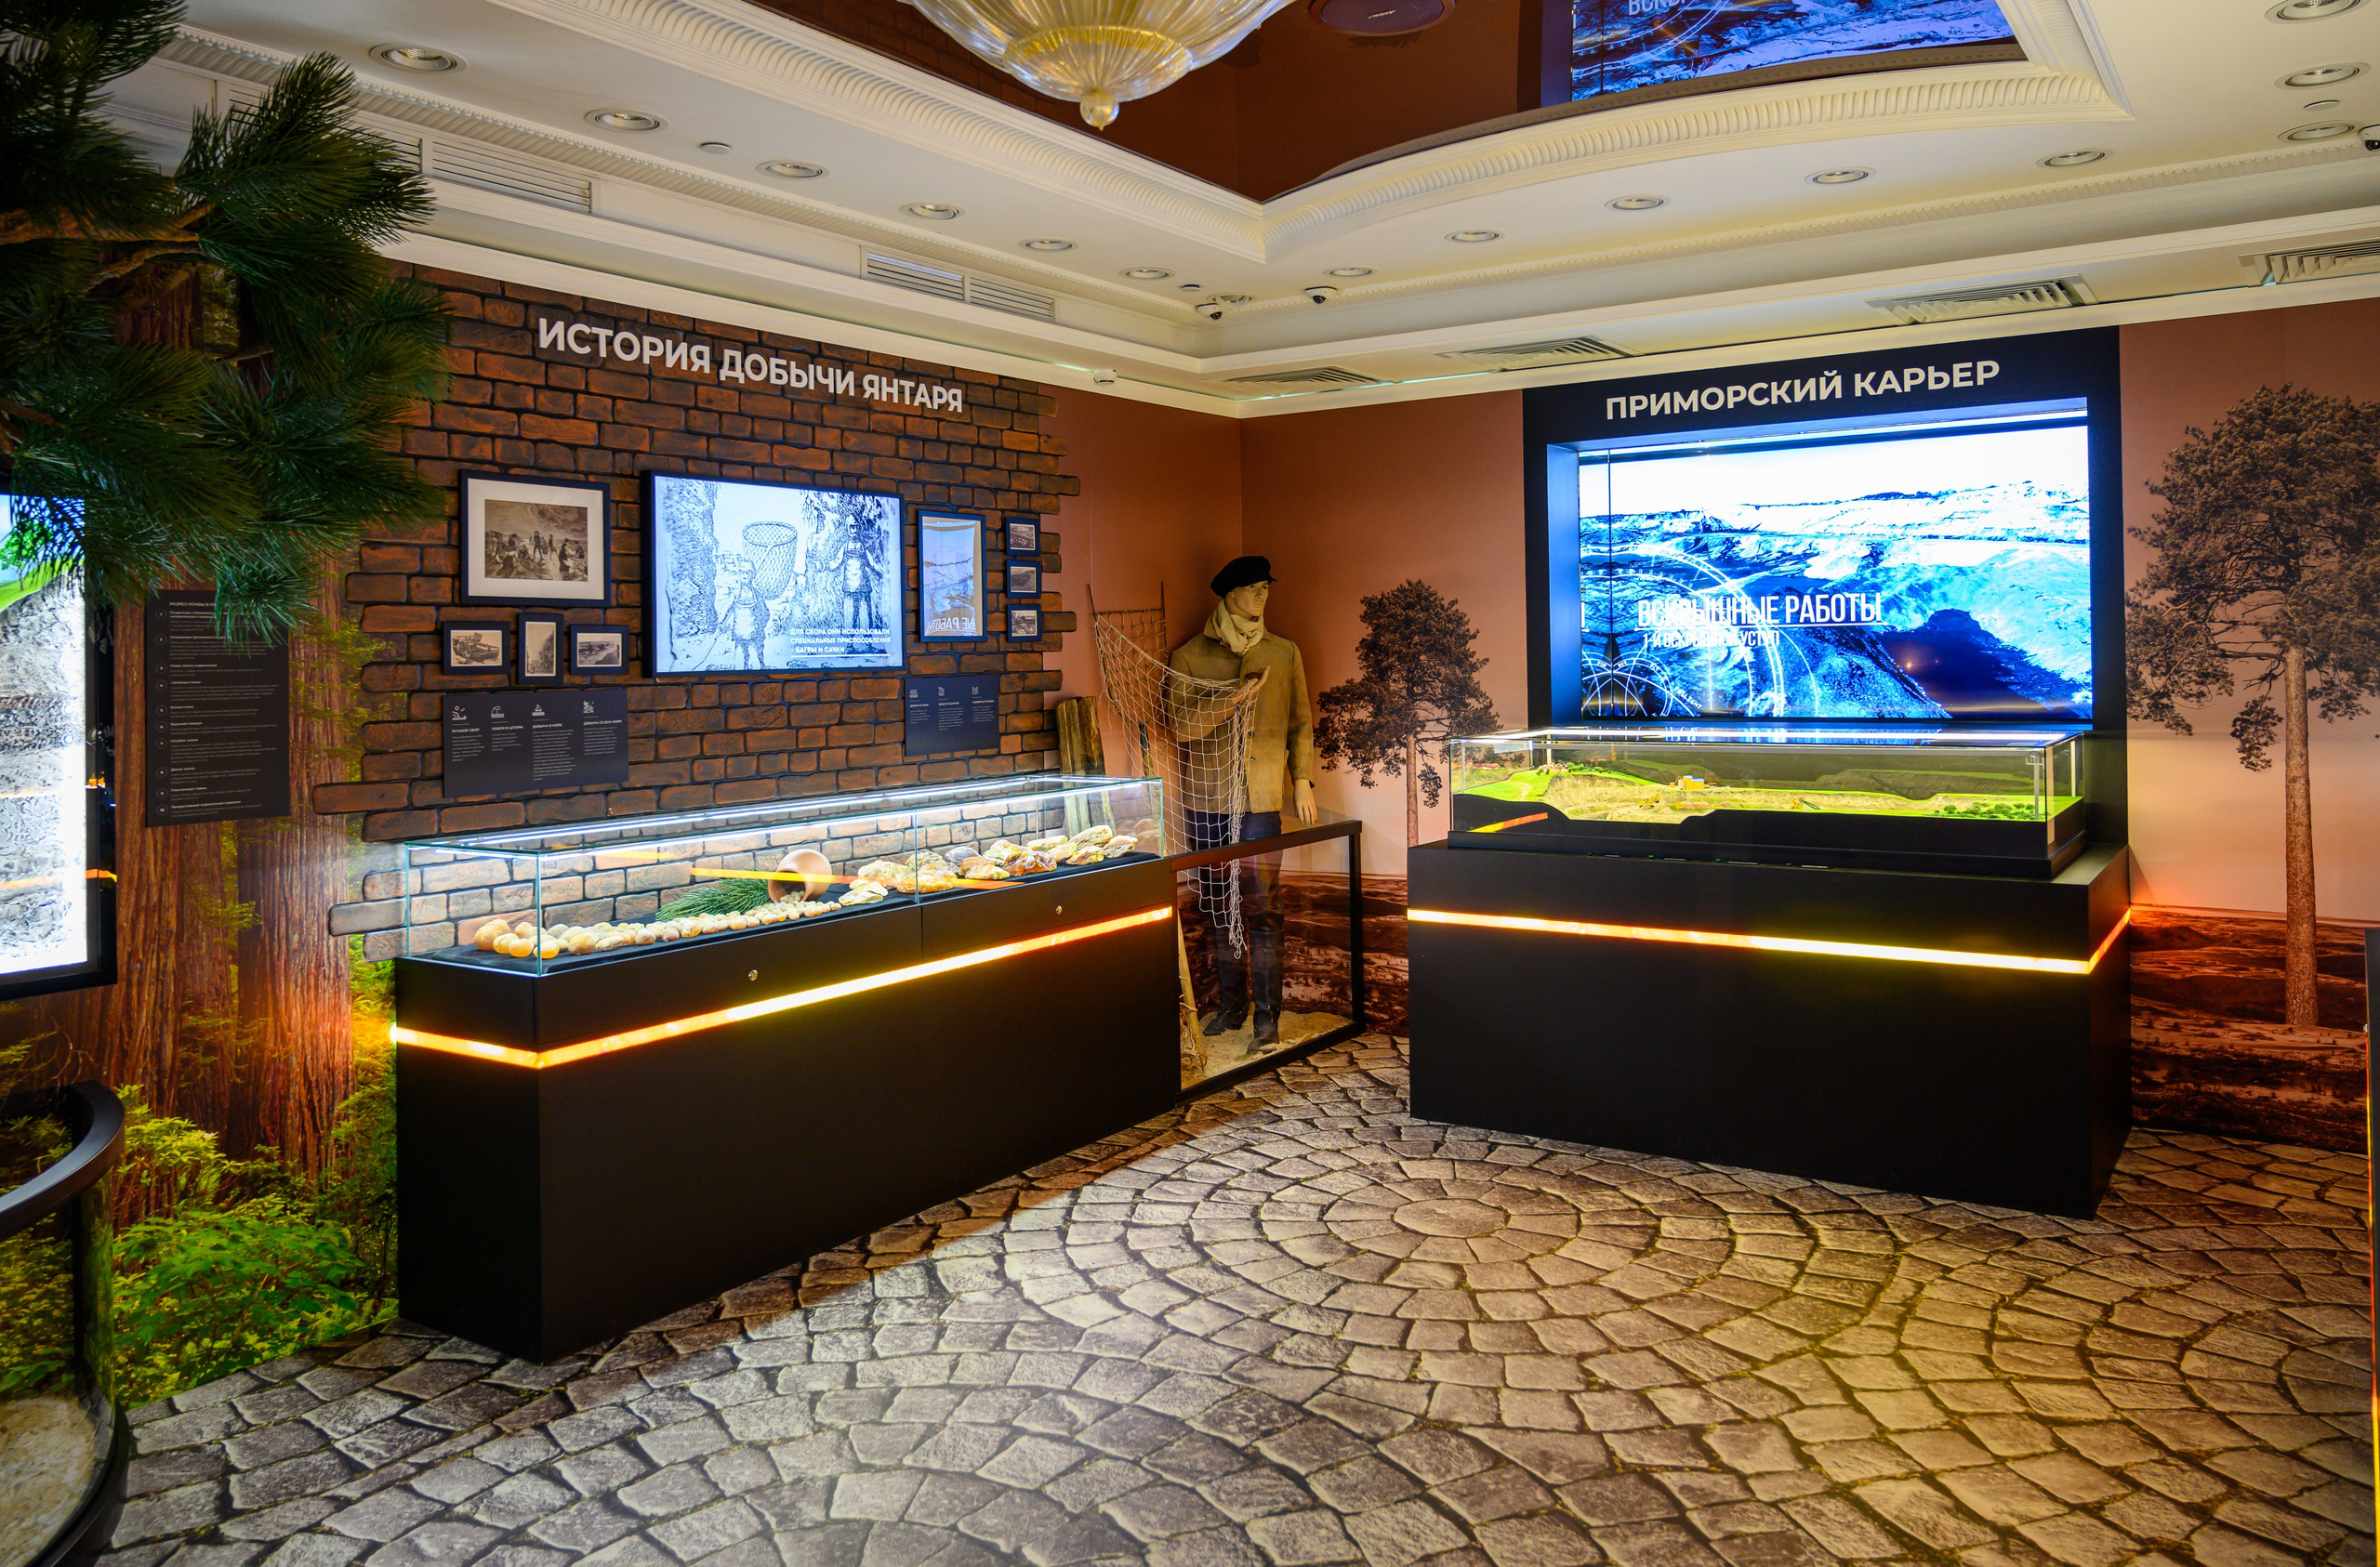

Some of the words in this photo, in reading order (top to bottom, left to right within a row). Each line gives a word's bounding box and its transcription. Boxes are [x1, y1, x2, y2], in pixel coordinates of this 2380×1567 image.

[538, 317, 711, 374] ИСТОРИЯ
[719, 349, 855, 398] ДОБЫЧИ
[861, 374, 963, 414] ЯНТАРЯ
[1606, 370, 1843, 421] ПРИМОРСКИЙ
[1854, 360, 2000, 398] КАРЬЕР
[1638, 595, 1779, 627] ВСКРЫШНЫЕ
[1785, 592, 1882, 624] РАБОТЫ
[1739, 630, 1780, 646] УСТУП
